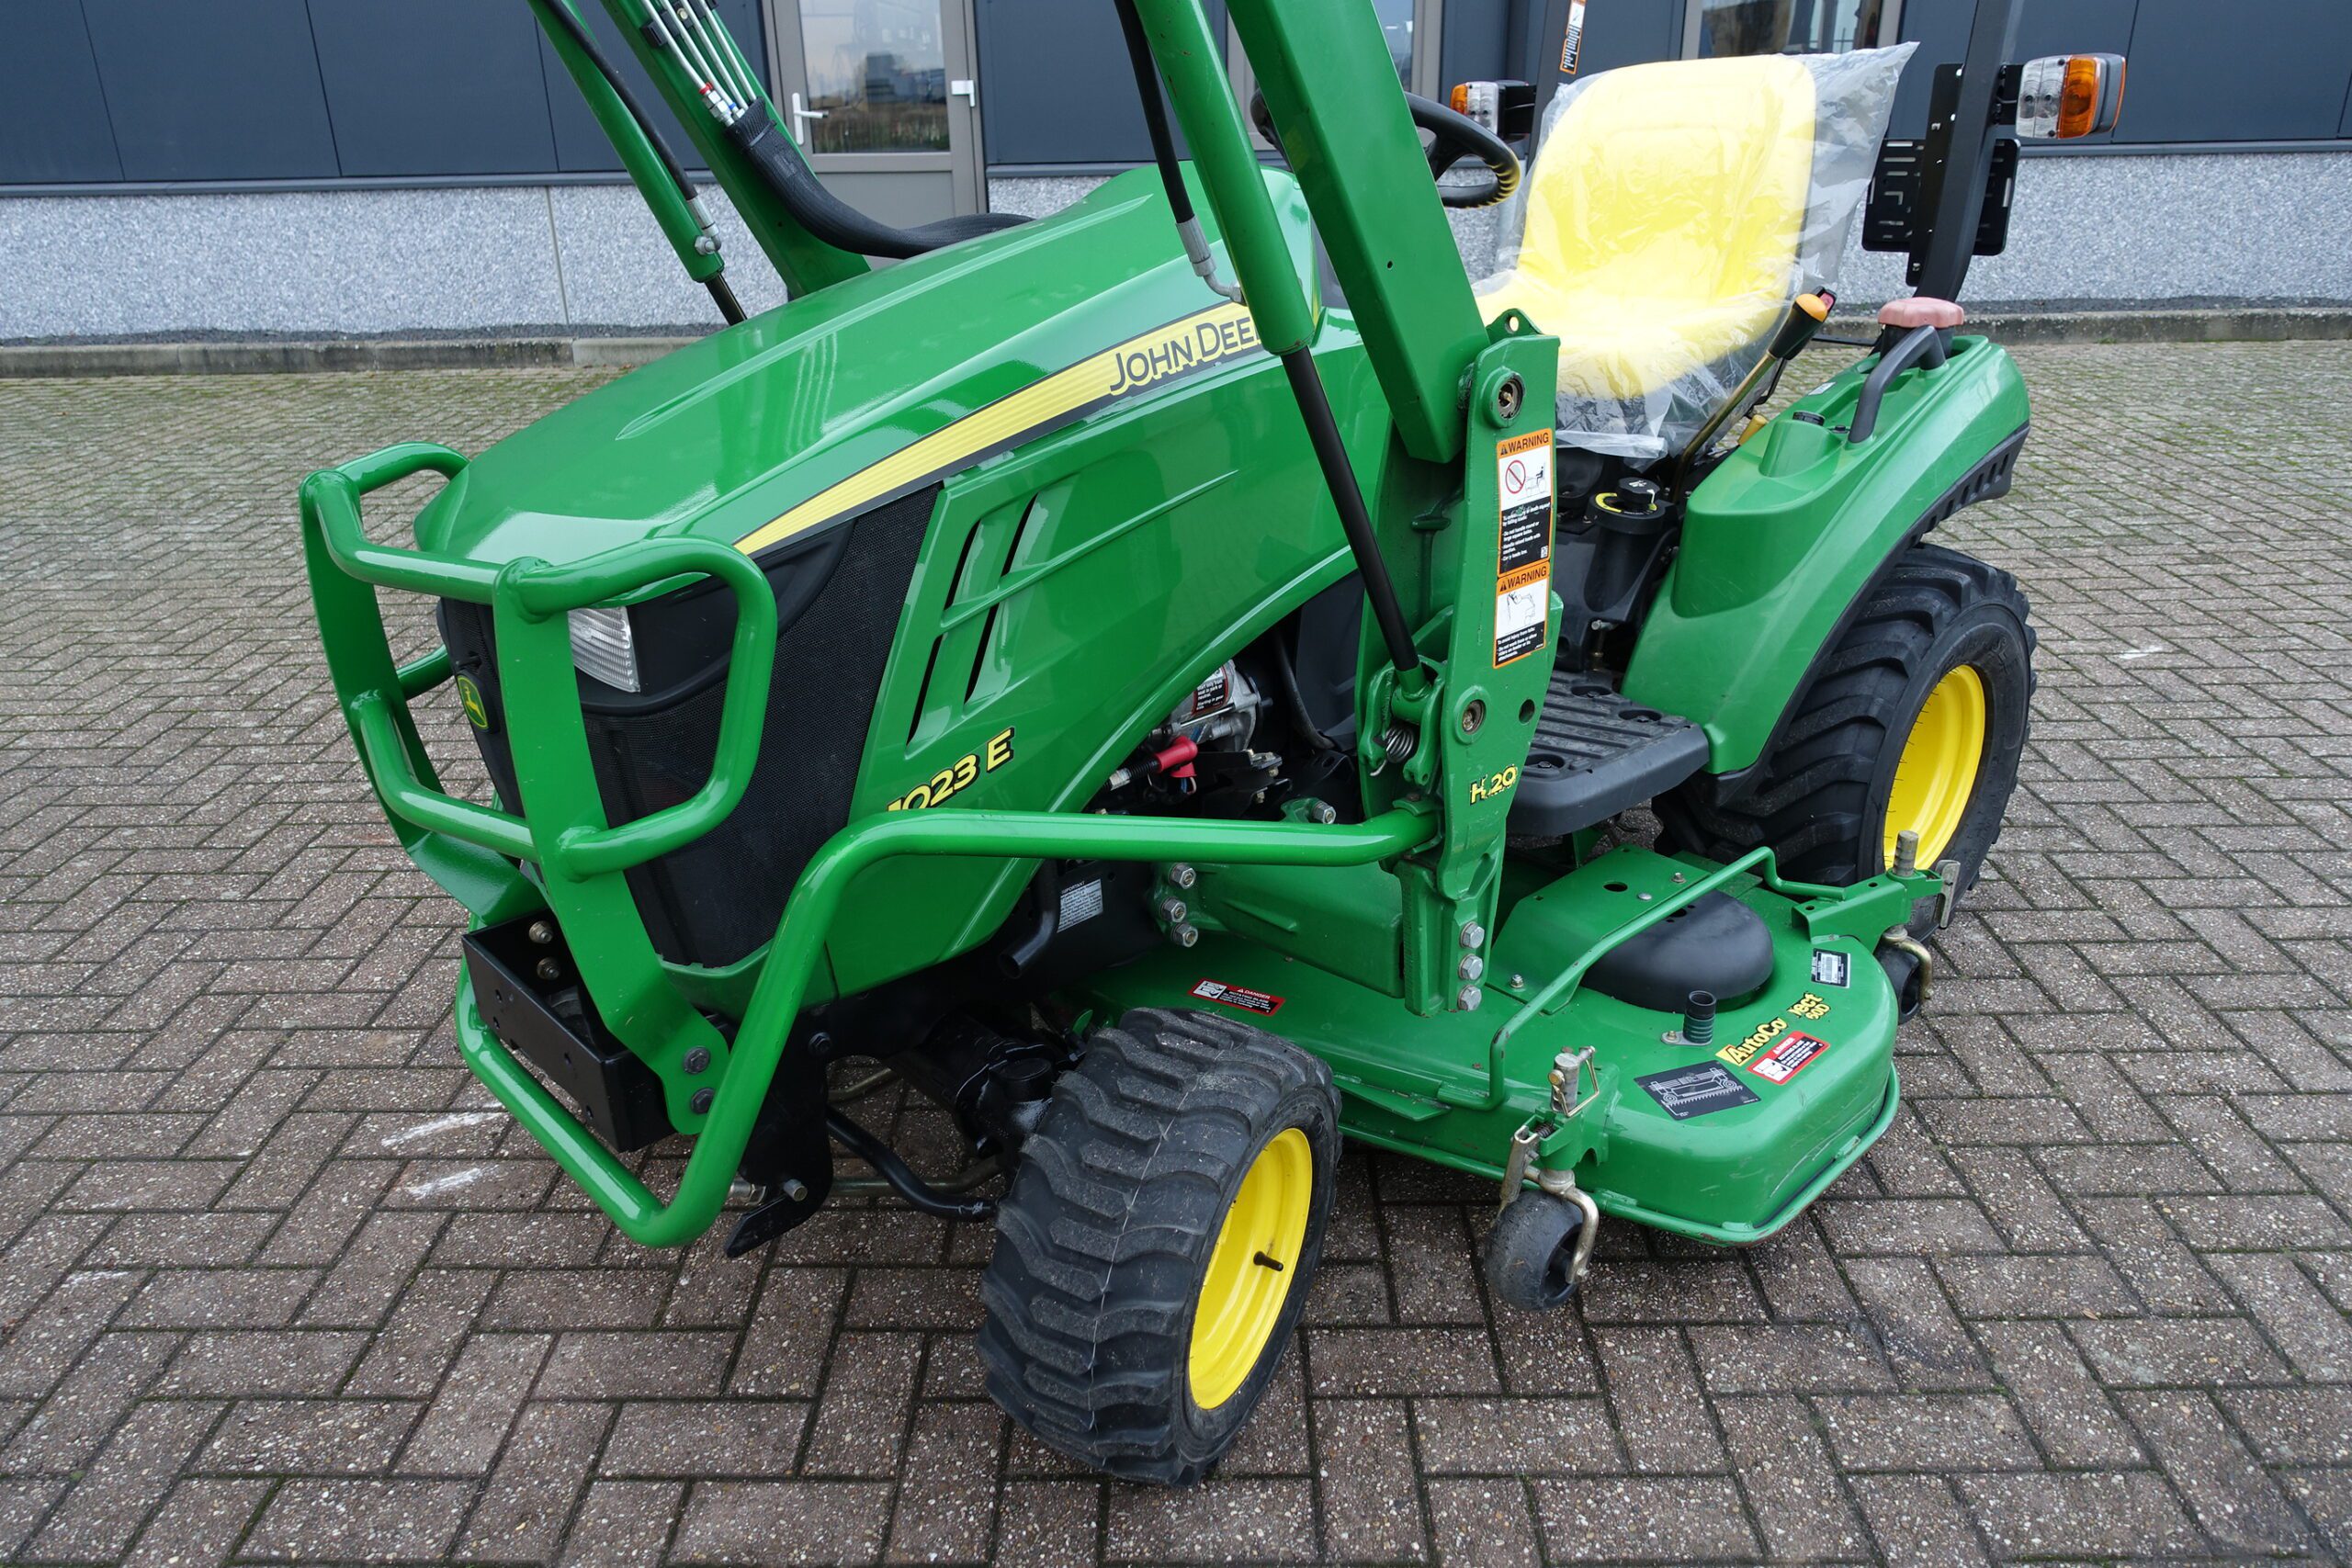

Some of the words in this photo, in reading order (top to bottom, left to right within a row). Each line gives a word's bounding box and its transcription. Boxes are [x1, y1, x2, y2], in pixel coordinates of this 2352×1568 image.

[1110, 334, 1193, 392] JOHN
[1195, 316, 1261, 362] DEE
[1508, 432, 1550, 454] WARNING
[1508, 566, 1547, 590] WARNING
[987, 728, 1014, 773] E
[1244, 989, 1271, 999] DANGER
